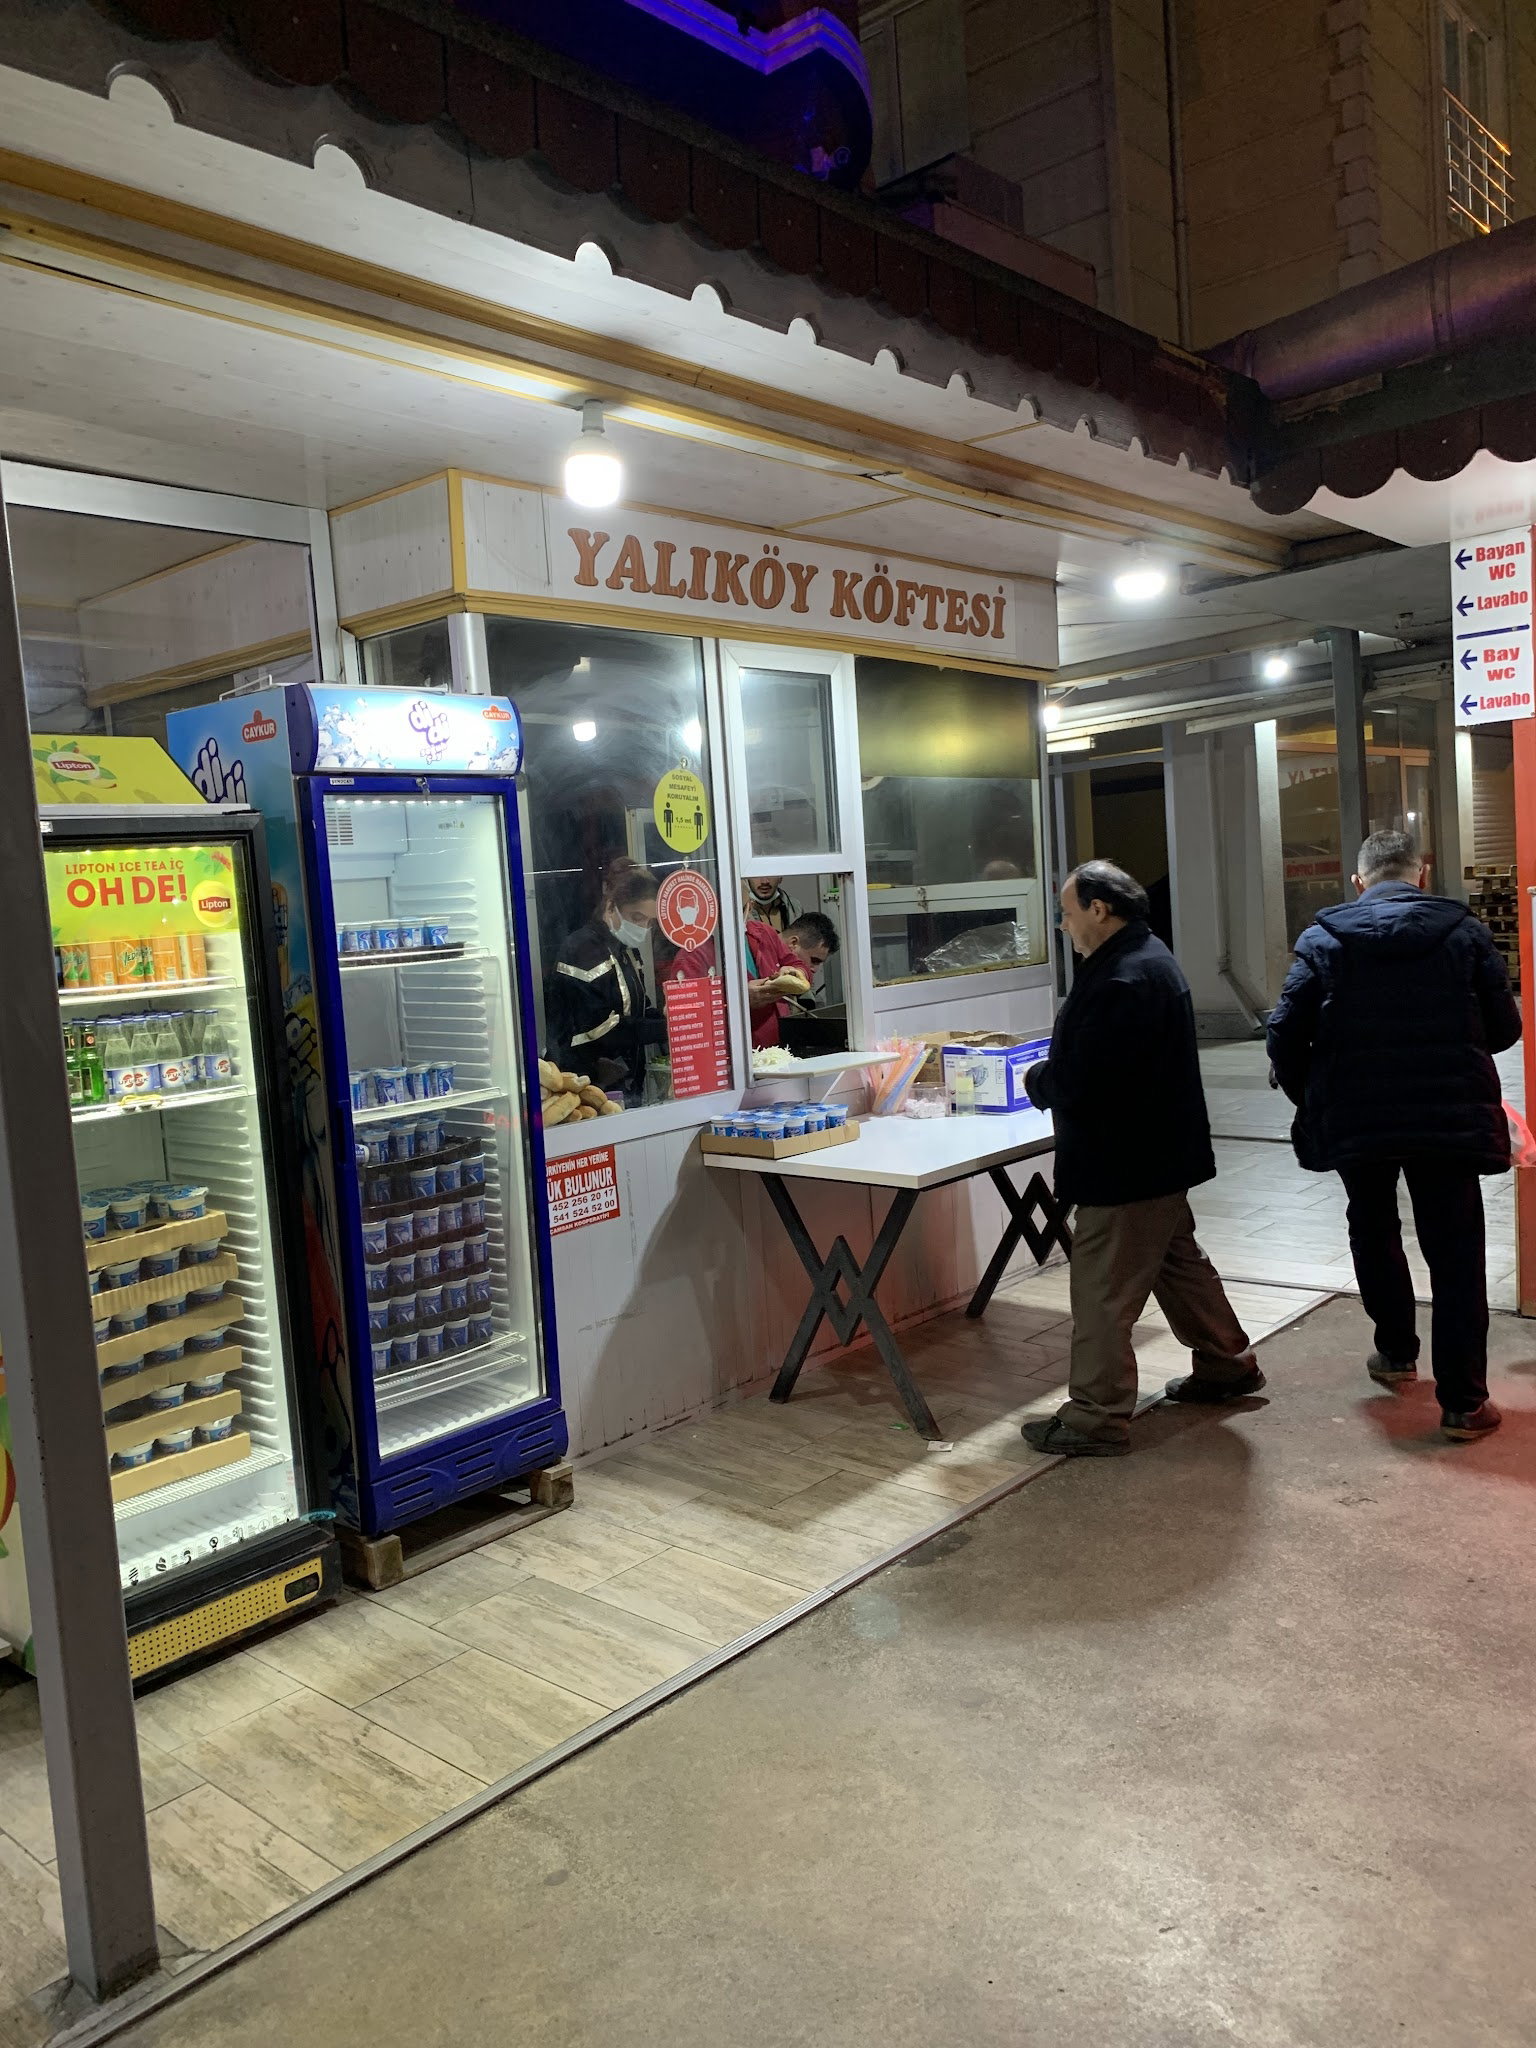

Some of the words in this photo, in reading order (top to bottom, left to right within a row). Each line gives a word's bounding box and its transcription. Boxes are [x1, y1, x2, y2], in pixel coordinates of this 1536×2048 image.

[1476, 541, 1525, 562] Bayan
[1488, 562, 1516, 580] WC
[567, 527, 819, 614] YALIKÖY
[829, 563, 1007, 640] KÖFTESİ
[1477, 590, 1529, 611] Lavabo
[1483, 647, 1520, 663] Bay
[1487, 667, 1516, 682] WC
[1480, 692, 1531, 710] Lavabo
[55, 761, 92, 770] Lipton
[671, 774, 693, 782] SOSYAL
[668, 783, 697, 792] MESAFEYİ
[666, 793, 699, 801] KORUYALIM
[65, 863, 115, 875] LIPTON
[119, 862, 141, 872] ICE
[144, 860, 167, 871] TEA
[169, 857, 184, 873] İÇ
[66, 877, 125, 908] OH
[131, 874, 188, 905] DE!
[201, 899, 229, 911] Lipton
[576, 1157, 588, 1169] HER
[588, 1151, 609, 1166] YERİNE
[564, 1166, 614, 1198] BULUNUR
[552, 1202, 569, 1212] 452
[572, 1195, 588, 1207] 256
[591, 1192, 601, 1201] 20
[604, 1188, 614, 1198] 17
[553, 1212, 569, 1224] 541
[572, 1207, 589, 1218] 524
[591, 1203, 602, 1212] 52
[604, 1199, 615, 1208] 00
